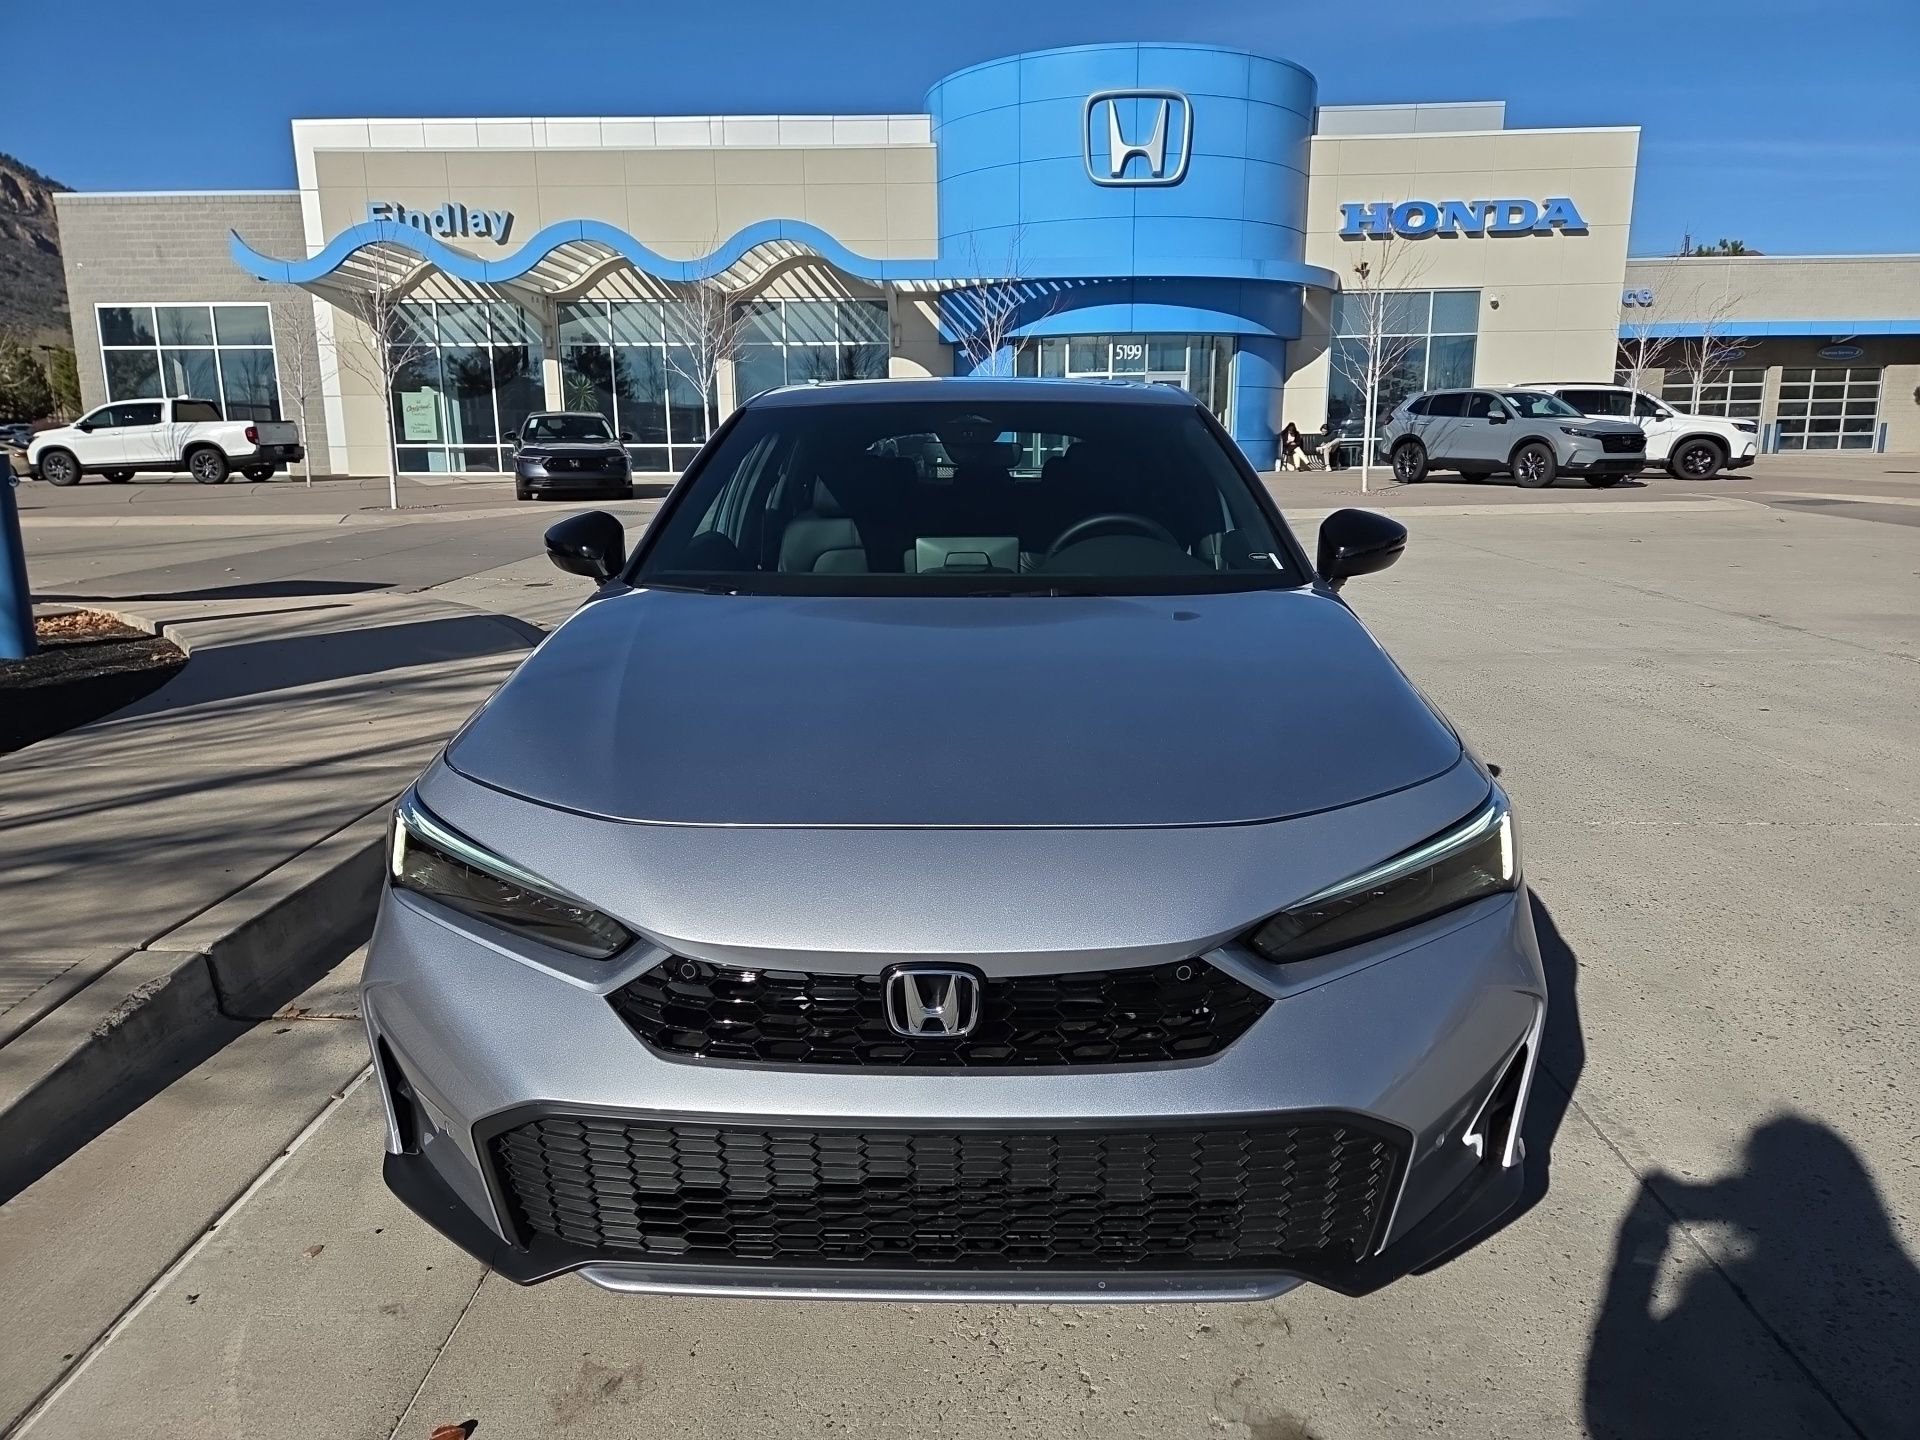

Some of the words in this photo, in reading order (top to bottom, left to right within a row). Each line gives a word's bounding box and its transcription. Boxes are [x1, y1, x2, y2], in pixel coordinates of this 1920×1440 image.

[366, 201, 512, 243] Findlay
[1339, 197, 1589, 239] HONDA
[1115, 344, 1142, 360] 5199
